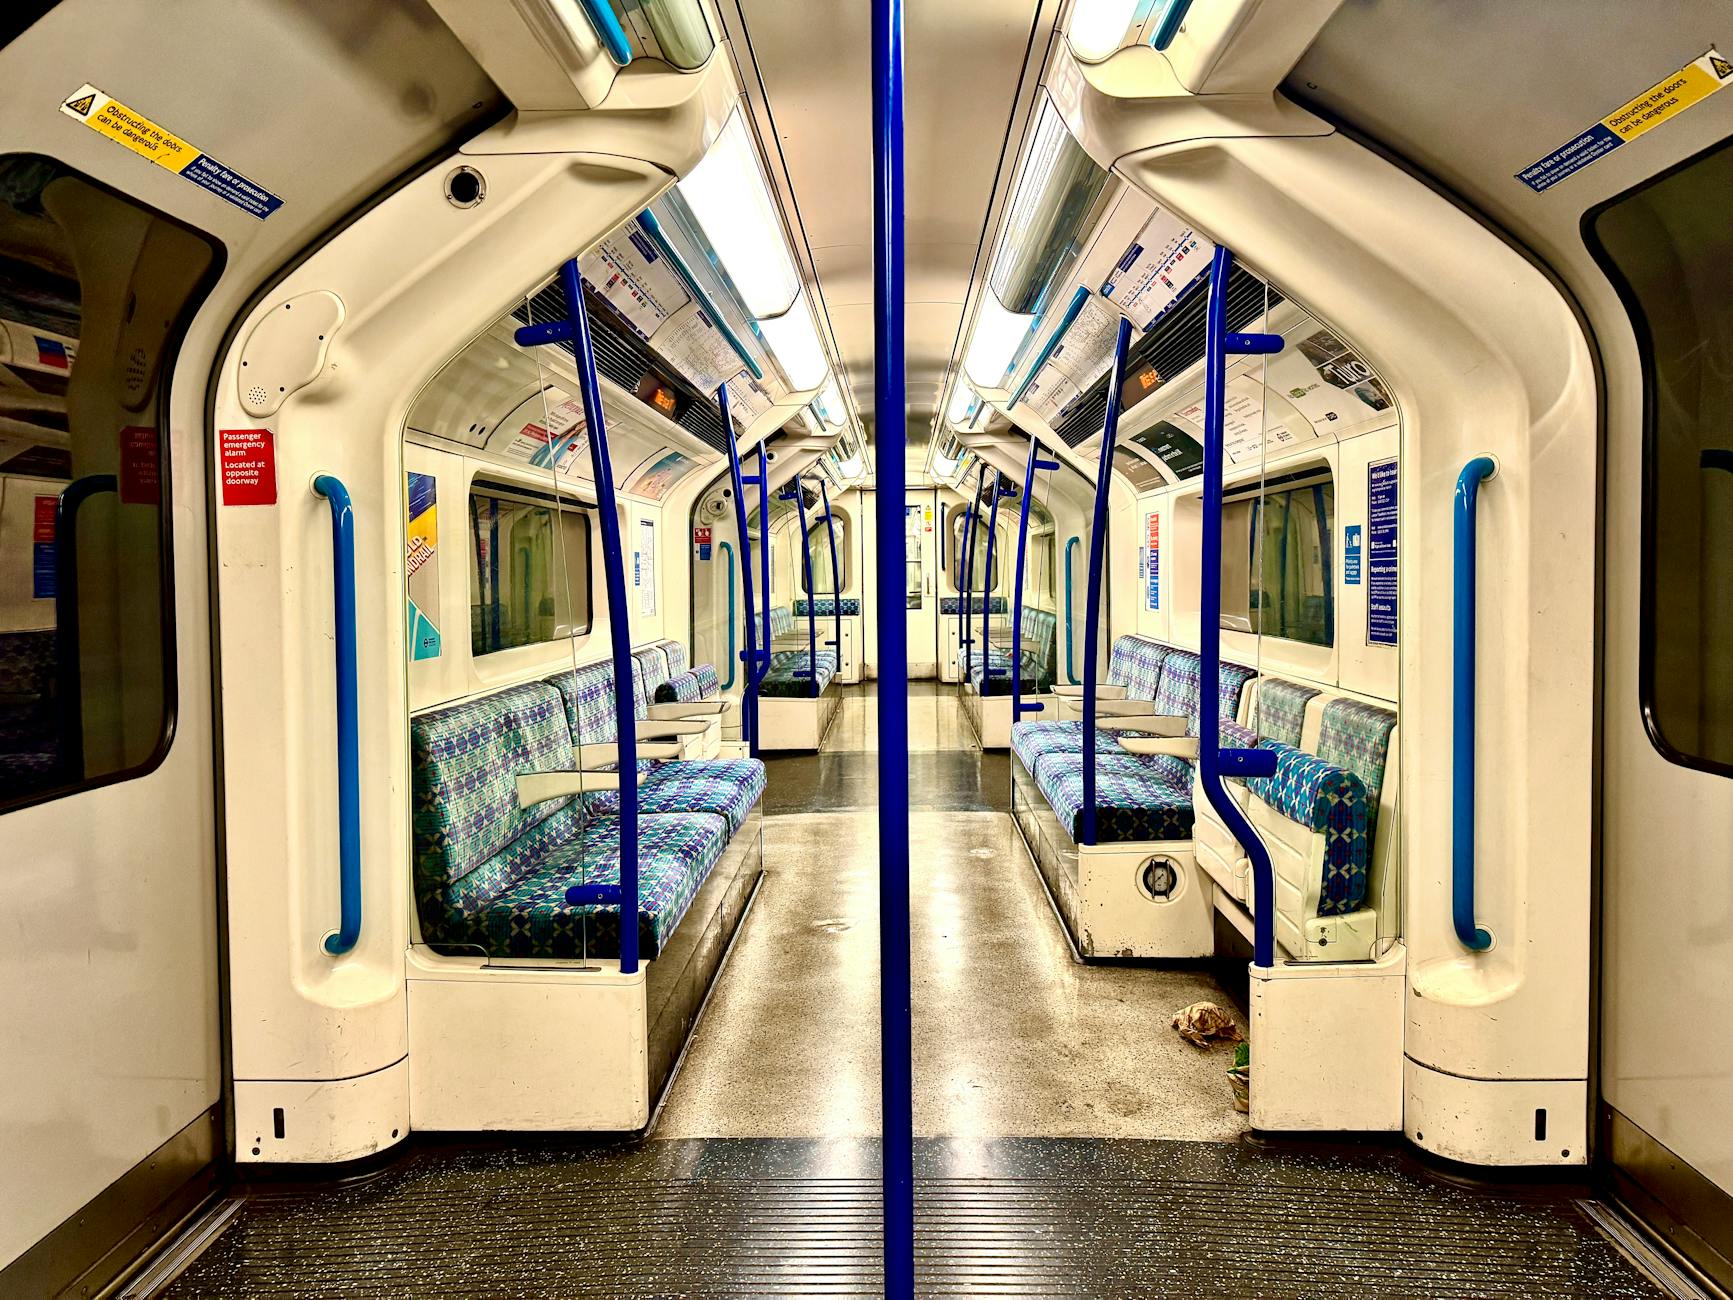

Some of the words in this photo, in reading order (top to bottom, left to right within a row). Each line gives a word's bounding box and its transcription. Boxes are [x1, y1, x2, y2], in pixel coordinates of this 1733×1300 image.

[1609, 100, 1653, 127] Obstructing
[1649, 92, 1665, 103] the
[1663, 78, 1687, 94] doors
[1619, 124, 1633, 134] can
[1631, 118, 1643, 126] be
[1641, 96, 1679, 120] dangerous
[97, 114, 112, 125] can
[111, 120, 123, 131] be
[122, 128, 159, 151] dangerous
[106, 105, 151, 135] Obstructing
[149, 130, 163, 142] the
[162, 138, 182, 153] doors
[1521, 166, 1545, 180] Penalty
[1540, 159, 1556, 169] fare
[1559, 134, 1594, 159] prosecution
[197, 157, 222, 175] Penalty
[219, 170, 233, 181] fare
[231, 177, 240, 185] or
[236, 182, 269, 202] prosecution
[1323, 361, 1370, 384] Turo
[223, 432, 262, 441] Passenger
[223, 441, 265, 449] emergency
[224, 461, 256, 469] Located
[225, 469, 259, 478] opposite
[225, 478, 259, 486] doorway
